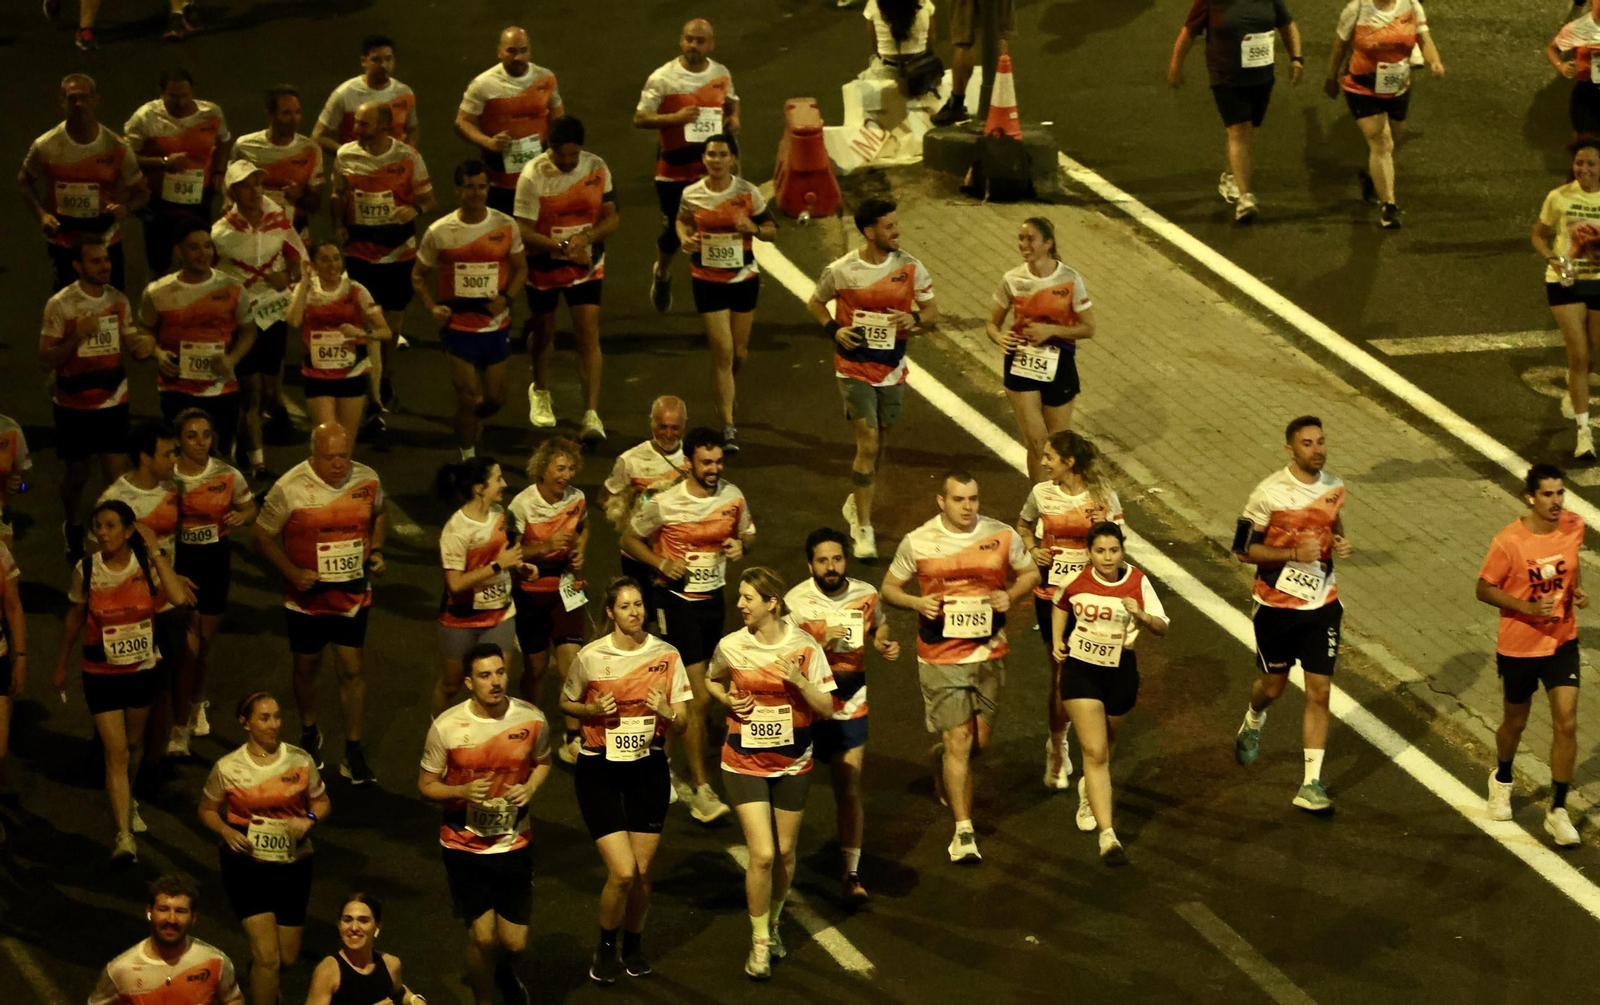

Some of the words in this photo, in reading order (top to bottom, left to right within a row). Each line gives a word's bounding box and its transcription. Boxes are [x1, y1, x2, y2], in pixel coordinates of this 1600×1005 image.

[692, 121, 716, 133] 3251
[708, 246, 735, 259] 5399
[462, 276, 489, 289] 3007
[318, 346, 347, 360] 6475
[1020, 354, 1048, 372] 8154
[323, 556, 361, 572] 11367
[950, 613, 986, 627] 19785
[108, 639, 148, 656] 12306
[1077, 639, 1116, 657] 19787
[750, 722, 784, 740] 9882
[615, 734, 647, 751] 9885
